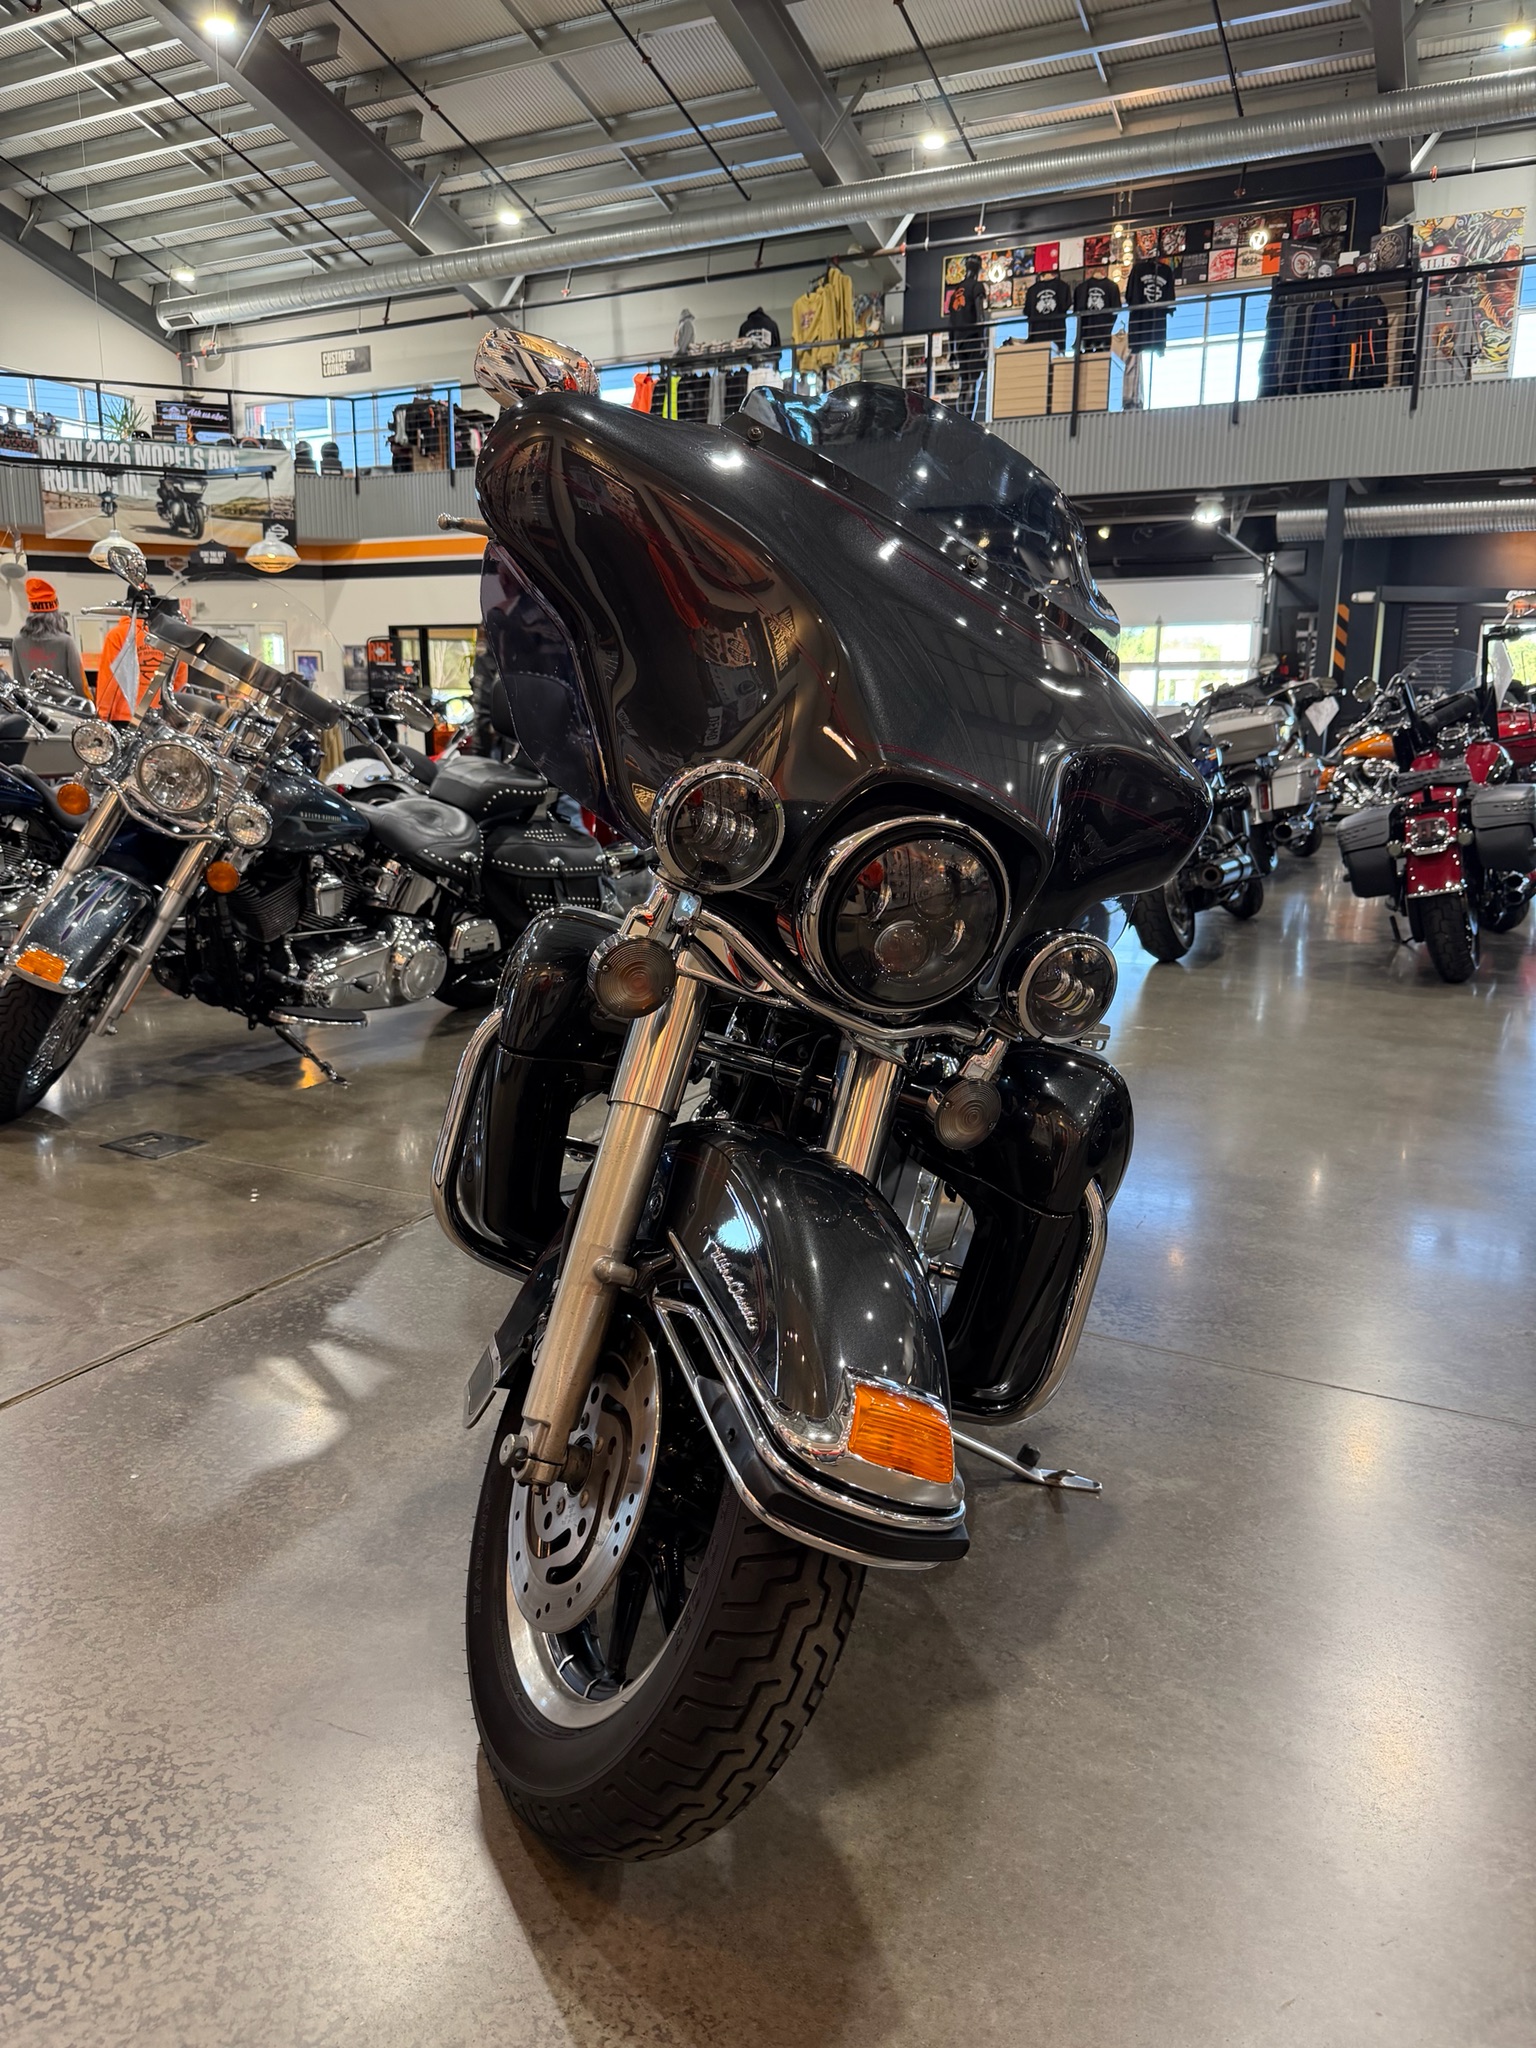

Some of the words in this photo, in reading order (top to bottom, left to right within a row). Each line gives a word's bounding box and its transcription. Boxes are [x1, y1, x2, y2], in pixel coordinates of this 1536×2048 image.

[1421, 255, 1458, 270] ILLS
[323, 349, 355, 364] CUSTOMER
[323, 362, 347, 376] LOUNGE
[39, 437, 82, 461] NEW
[86, 441, 131, 465] 2026
[135, 445, 205, 470] MODELS
[208, 449, 240, 469] ARE
